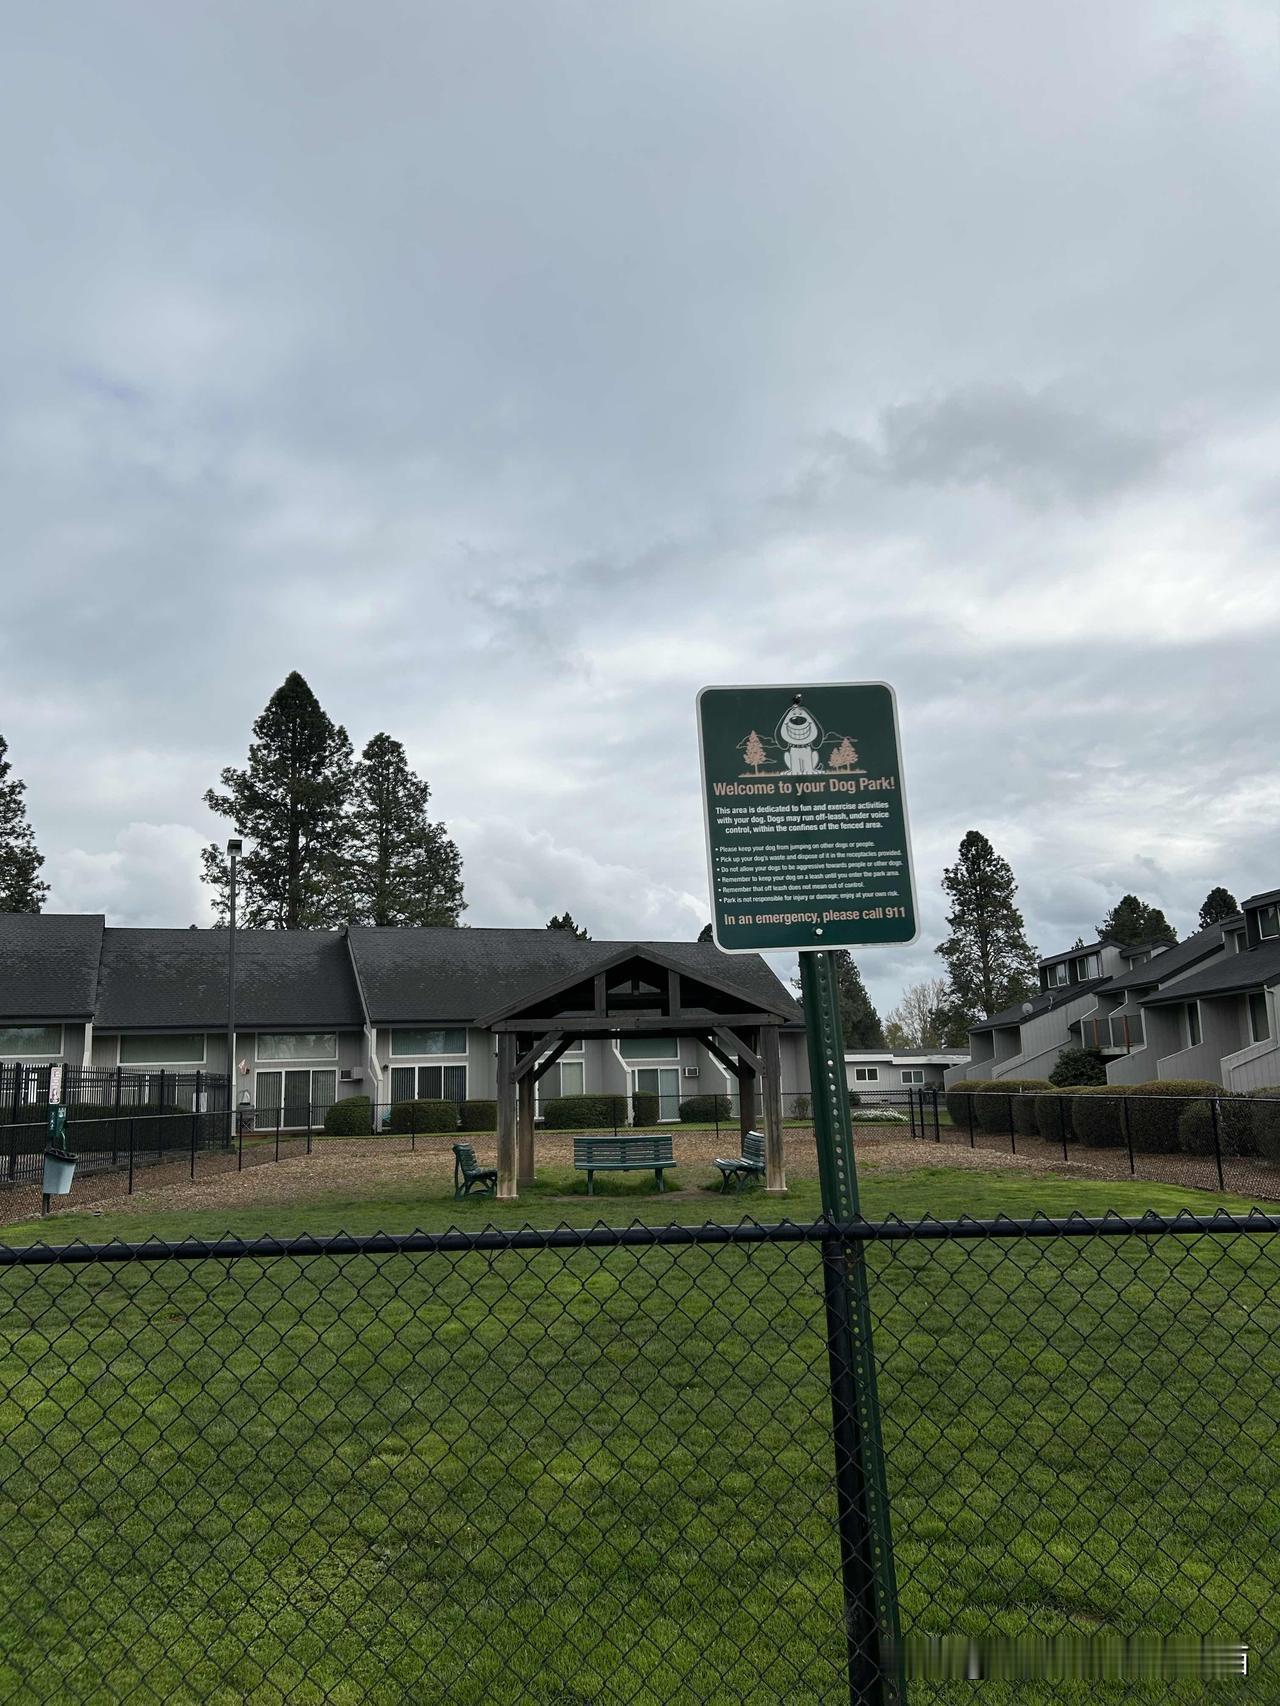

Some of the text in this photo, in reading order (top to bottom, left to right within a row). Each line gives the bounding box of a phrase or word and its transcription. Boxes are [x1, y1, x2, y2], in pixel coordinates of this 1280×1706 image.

[713, 777, 895, 796] Welcome to your Dog Park!
[756, 805, 791, 813] dedicated
[857, 801, 889, 809] activities
[734, 817, 749, 825] your
[751, 816, 766, 824] dog.
[767, 815, 785, 823] Dogs
[815, 813, 848, 821] off-leash,
[725, 826, 752, 834] control,
[840, 821, 864, 829] fenced
[796, 863, 825, 871] aggressive
[724, 908, 905, 925] In an emergency, please call 911
